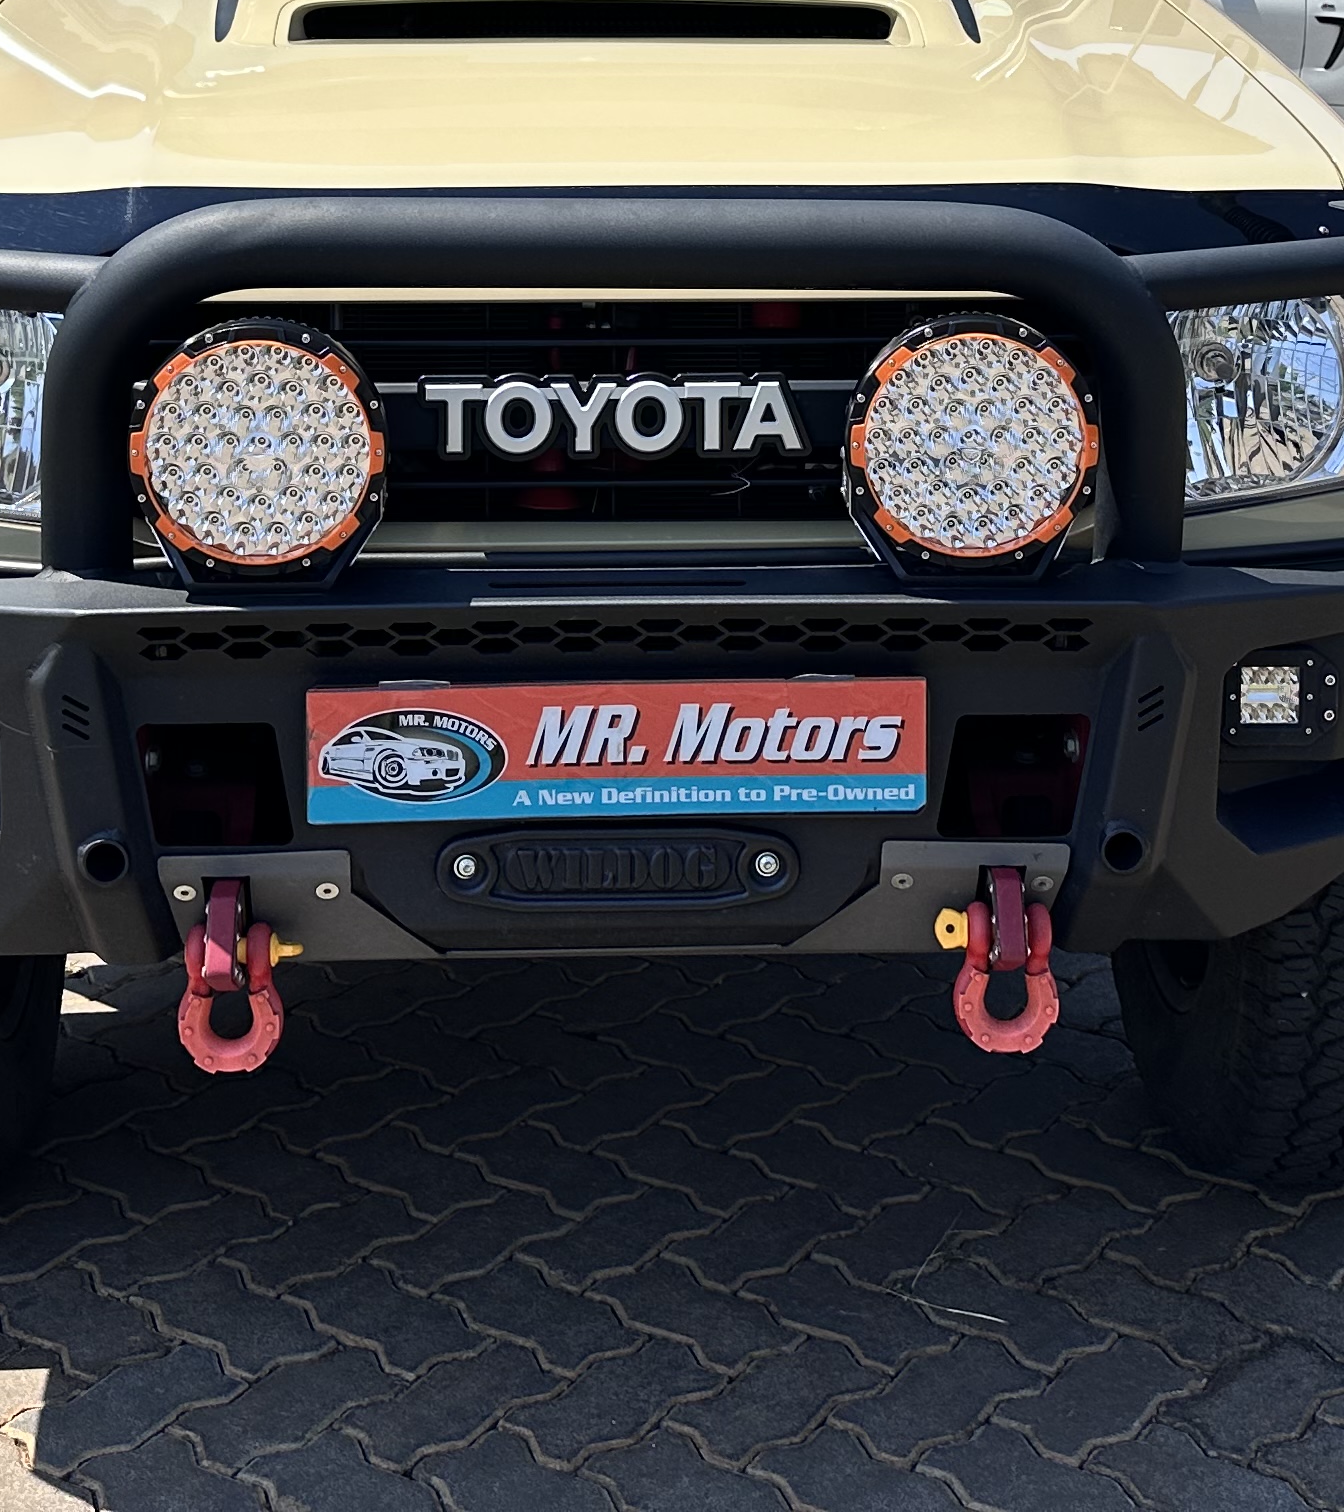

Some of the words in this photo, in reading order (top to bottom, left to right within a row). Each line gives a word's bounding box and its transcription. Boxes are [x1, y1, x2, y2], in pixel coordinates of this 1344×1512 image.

[425, 380, 804, 454] TOYOTA
[398, 714, 429, 727] MR.
[433, 715, 498, 751] MOTORS
[525, 705, 647, 765] MR.
[665, 702, 903, 764] Motors
[512, 790, 532, 806] A
[538, 789, 595, 806] New
[601, 786, 734, 805] Definition
[738, 786, 767, 802] to
[775, 785, 916, 802] Pre-Owned
[517, 845, 720, 890] WILDOG
